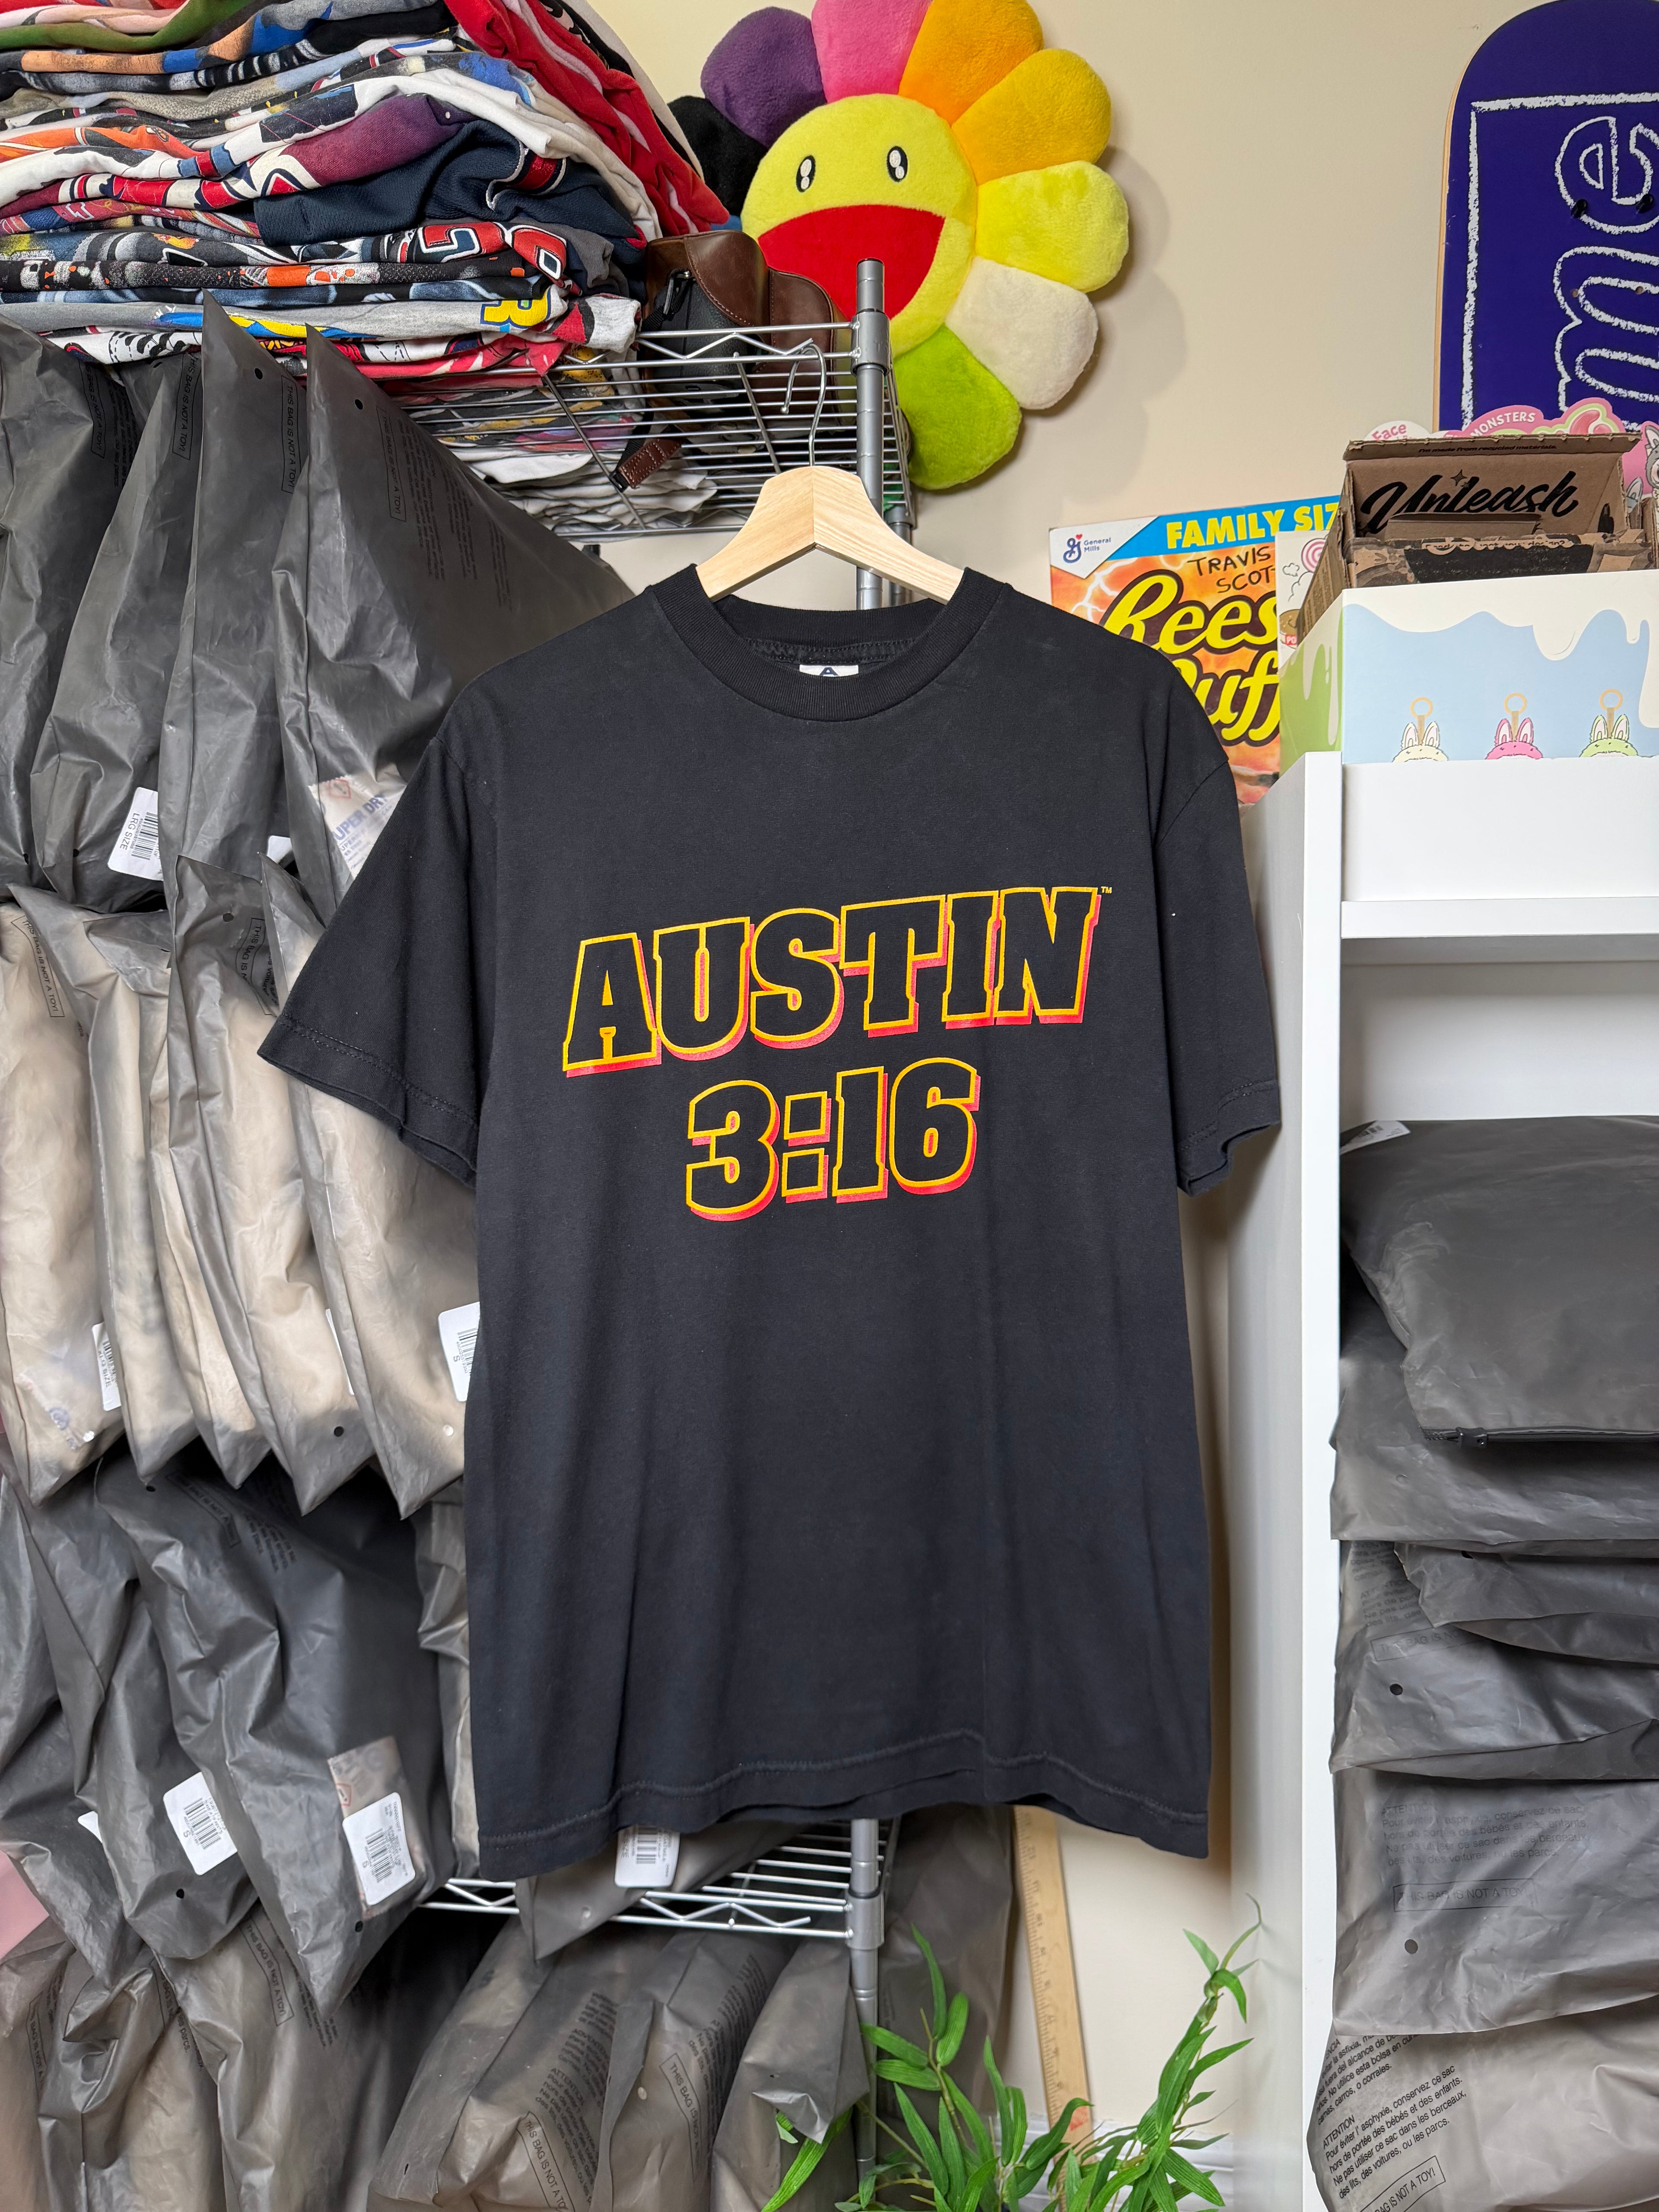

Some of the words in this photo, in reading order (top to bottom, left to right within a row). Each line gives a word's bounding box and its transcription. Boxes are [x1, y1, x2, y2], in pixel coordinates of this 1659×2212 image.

[183, 374, 193, 393] BAG
[182, 395, 190, 404] IS
[1468, 410, 1537, 436] MONSTERS
[178, 433, 187, 451] TOY!
[1359, 470, 1579, 534] Unleash
[1167, 509, 1285, 549] FAMILY
[1293, 502, 1339, 531] SIZ
[1084, 537, 1111, 546] General
[1187, 546, 1271, 576] TRAVIS
[1216, 566, 1275, 593] SCOT
[127, 813, 140, 830] LRG
[332, 807, 367, 842] UPER
[119, 831, 133, 850] SIZE
[251, 925, 261, 944] THIS
[22, 918, 34, 936] THIS
[40, 965, 50, 984] NOT
[48, 993, 58, 1012] TOY!
[241, 962, 248, 970] IS
[563, 887, 1101, 1077] AUSTIN
[686, 1057, 980, 1221] 3:16
[182, 1829, 192, 1838] S
[1382, 1818, 1403, 1828] Pour
[1480, 1824, 1510, 1834] bébés
[1385, 1844, 1398, 1853] Ne
[1472, 1839, 1491, 1847] sac
[1528, 1847, 1559, 1859] parcs.
[1453, 1889, 1463, 1899] IS
[1466, 1888, 1489, 1898] NOT
[1492, 1888, 1500, 1897] A
[179, 2028, 191, 2053] parcs.
[1338, 2039, 1361, 2058] asfixia,
[1337, 2062, 1347, 2073] del
[1346, 2044, 1373, 2066] alcance
[1374, 2037, 1385, 2047] de
[1328, 2086, 1337, 2097] No
[1336, 2072, 1354, 2088] utilice
[1354, 2061, 1370, 2075] esta
[1370, 2047, 1390, 2064] bolsa
[1391, 2042, 1401, 2051] en
[668, 2062, 685, 2086] THIS
[679, 2085, 693, 2108] BAG
[689, 2107, 699, 2118] IS
[1334, 2086, 1355, 2105] carros,
[1355, 2081, 1362, 2089] o
[1361, 2062, 1391, 2084] corrales.
[1325, 2144, 1339, 2160] Pour
[1338, 2131, 1356, 2148] éviter
[1361, 2104, 1392, 2132] asphyxie,
[1392, 2081, 1430, 2108] conservez
[1431, 2075, 1442, 2085] ce
[1441, 2066, 1456, 2078] sac
[1328, 2158, 1342, 2173] hors
[1341, 2151, 1352, 2161] de
[1350, 2134, 1372, 2156] portée
[1371, 2124, 1386, 2137] des
[1385, 2108, 1409, 2128] bébés
[1409, 2104, 1417, 2113] et
[1417, 2093, 1433, 2107] des
[1433, 2075, 1462, 2098] enfants.
[524, 2120, 537, 2139] THIS
[1321, 2115, 1355, 2148] ATTENTION
[1332, 2174, 1343, 2185] Ne
[1342, 2164, 1354, 2179] pas
[1354, 2148, 1375, 2168] utiliser
[1374, 2141, 1385, 2152] ce
[1384, 2132, 1398, 2144] sac
[1398, 2120, 1417, 2136] dans
[1417, 2111, 1429, 2123] les
[1429, 2089, 1466, 2116] berceaux,
[532, 2139, 546, 2159] BAG
[1338, 2184, 1350, 2198] des
[1349, 2177, 1361, 2189] lits,
[1360, 2165, 1373, 2179] des
[1373, 2146, 1401, 2169] voitures,
[1402, 2139, 1412, 2149] ou
[1412, 2130, 1424, 2142] les
[1425, 2117, 1449, 2136] parcs.
[540, 2159, 550, 2170] IS
[544, 2169, 557, 2188] NOT
[1389, 2196, 1397, 2207] IS
[1395, 2183, 1411, 2201] NOT
[1408, 2180, 1417, 2190] A
[1416, 2167, 1436, 2184] TOY!
[552, 2189, 561, 2198] A
